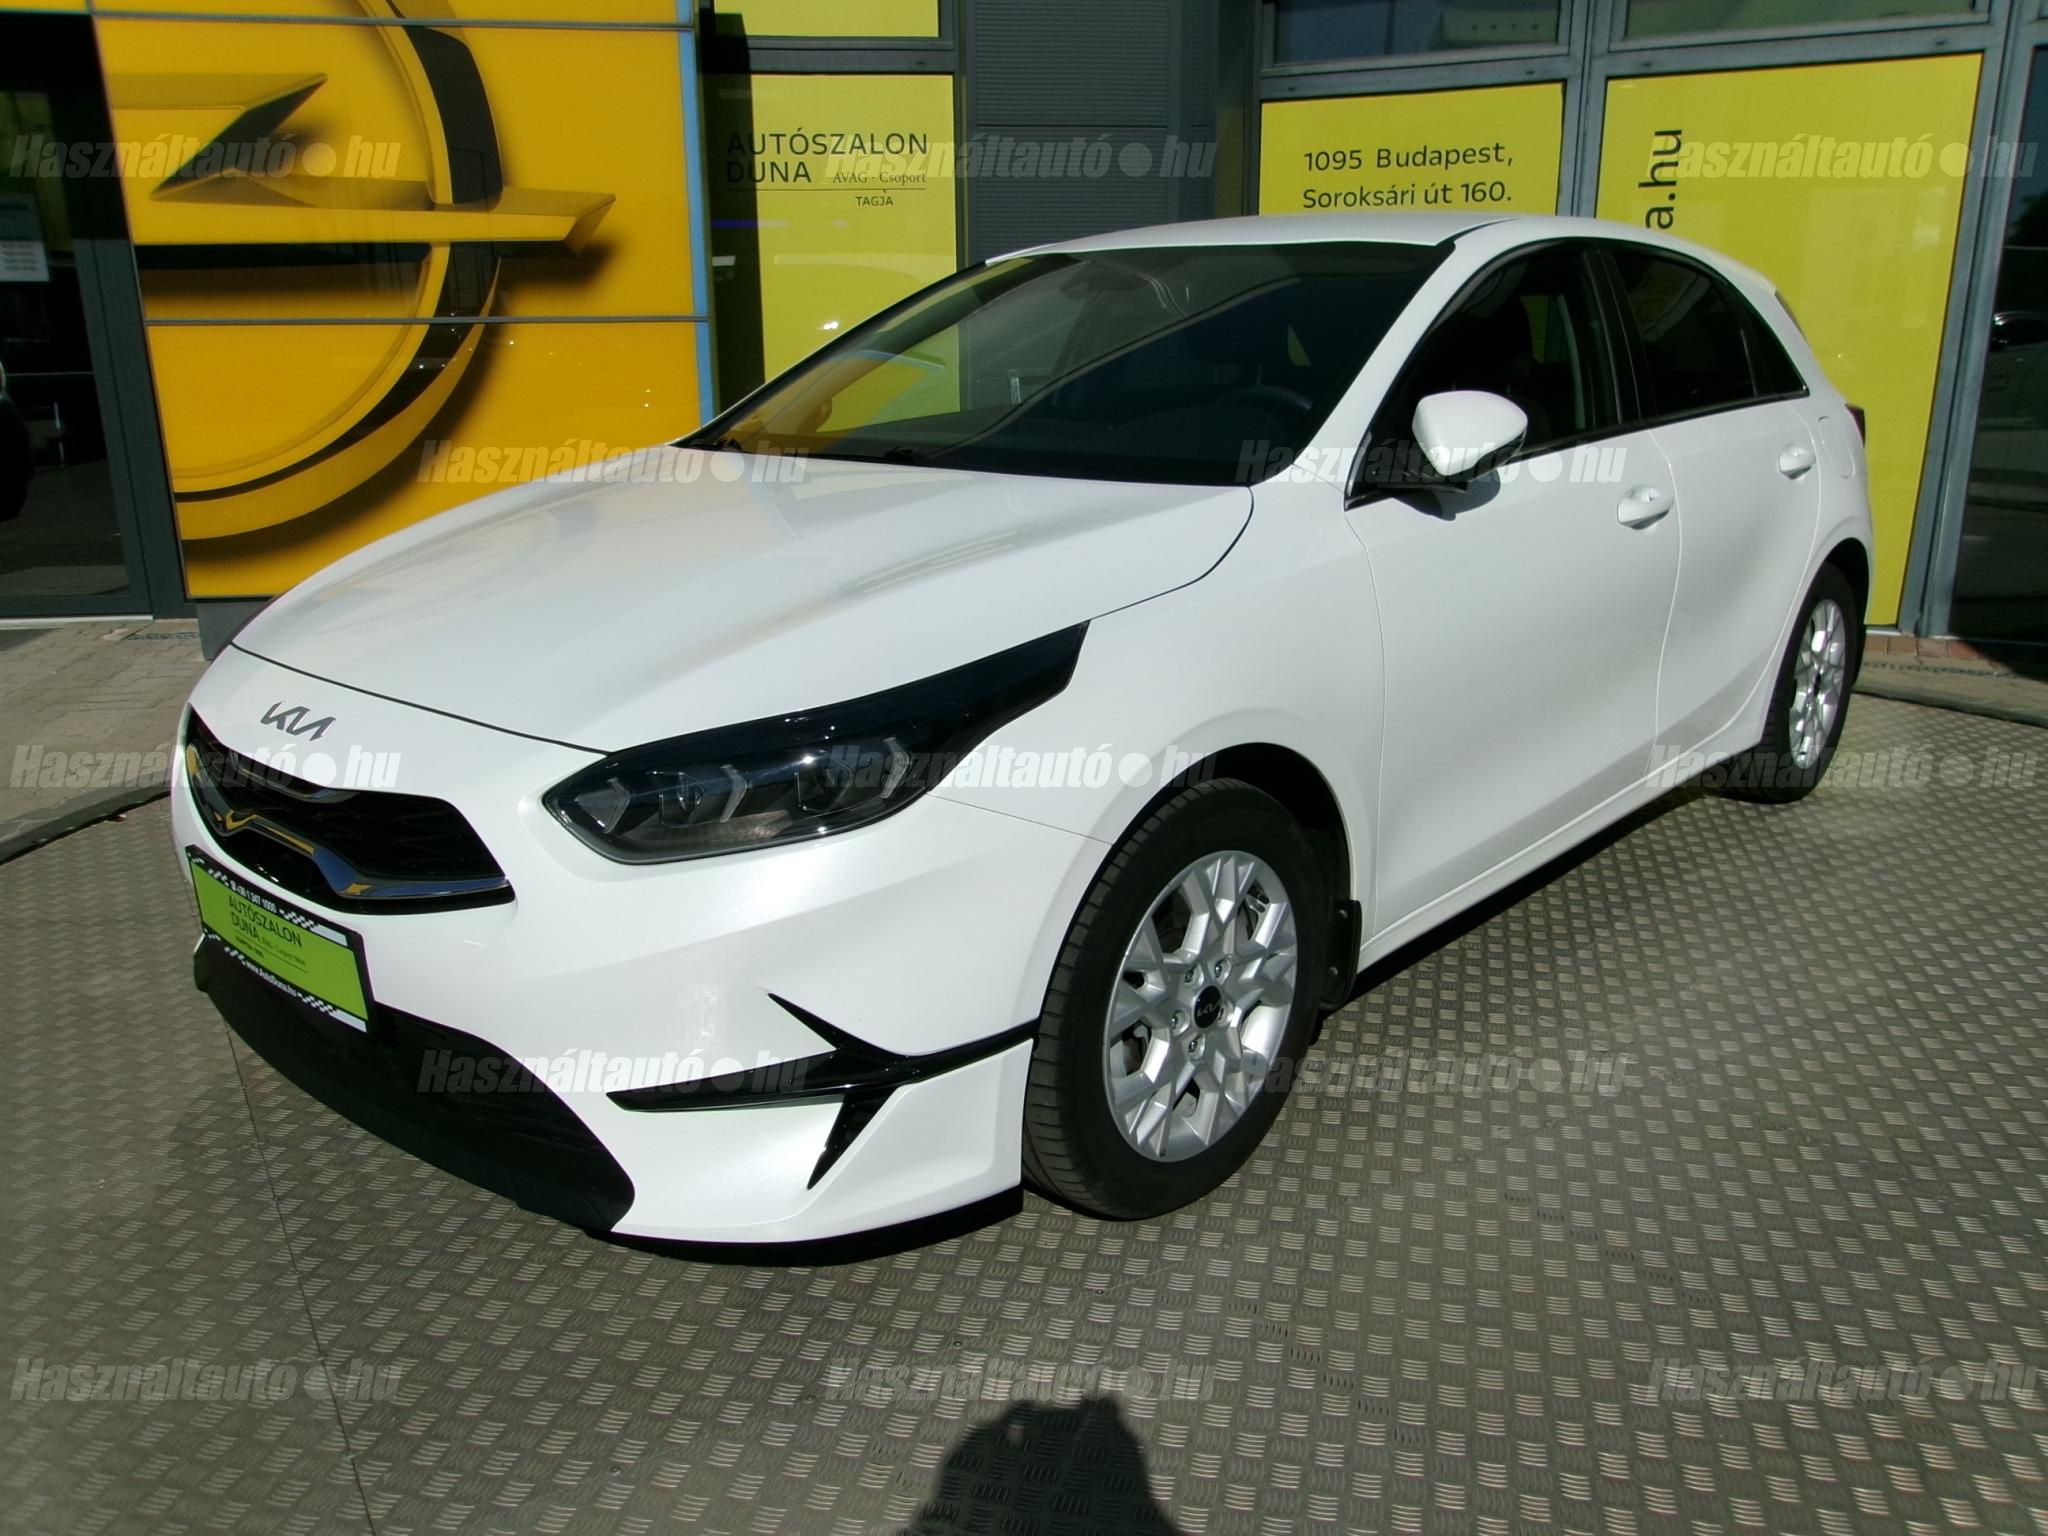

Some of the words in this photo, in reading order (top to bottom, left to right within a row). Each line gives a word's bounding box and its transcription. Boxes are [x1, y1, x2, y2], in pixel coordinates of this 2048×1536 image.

[727, 127, 927, 155] AUTÓSZALON
[1304, 149, 1363, 172] 1095
[1376, 142, 1513, 170] Budapest,
[726, 161, 812, 184] DUNA
[832, 172, 868, 184] AVAG
[879, 171, 926, 186] Csoport
[855, 196, 894, 207] TAGJA
[1303, 183, 1416, 209] Soroksári
[1424, 182, 1453, 205] út
[1460, 181, 1512, 204] 160.
[260, 701, 337, 741] KIA
[229, 895, 302, 948] AUTÓSZALON
[231, 911, 261, 941] DUNA
